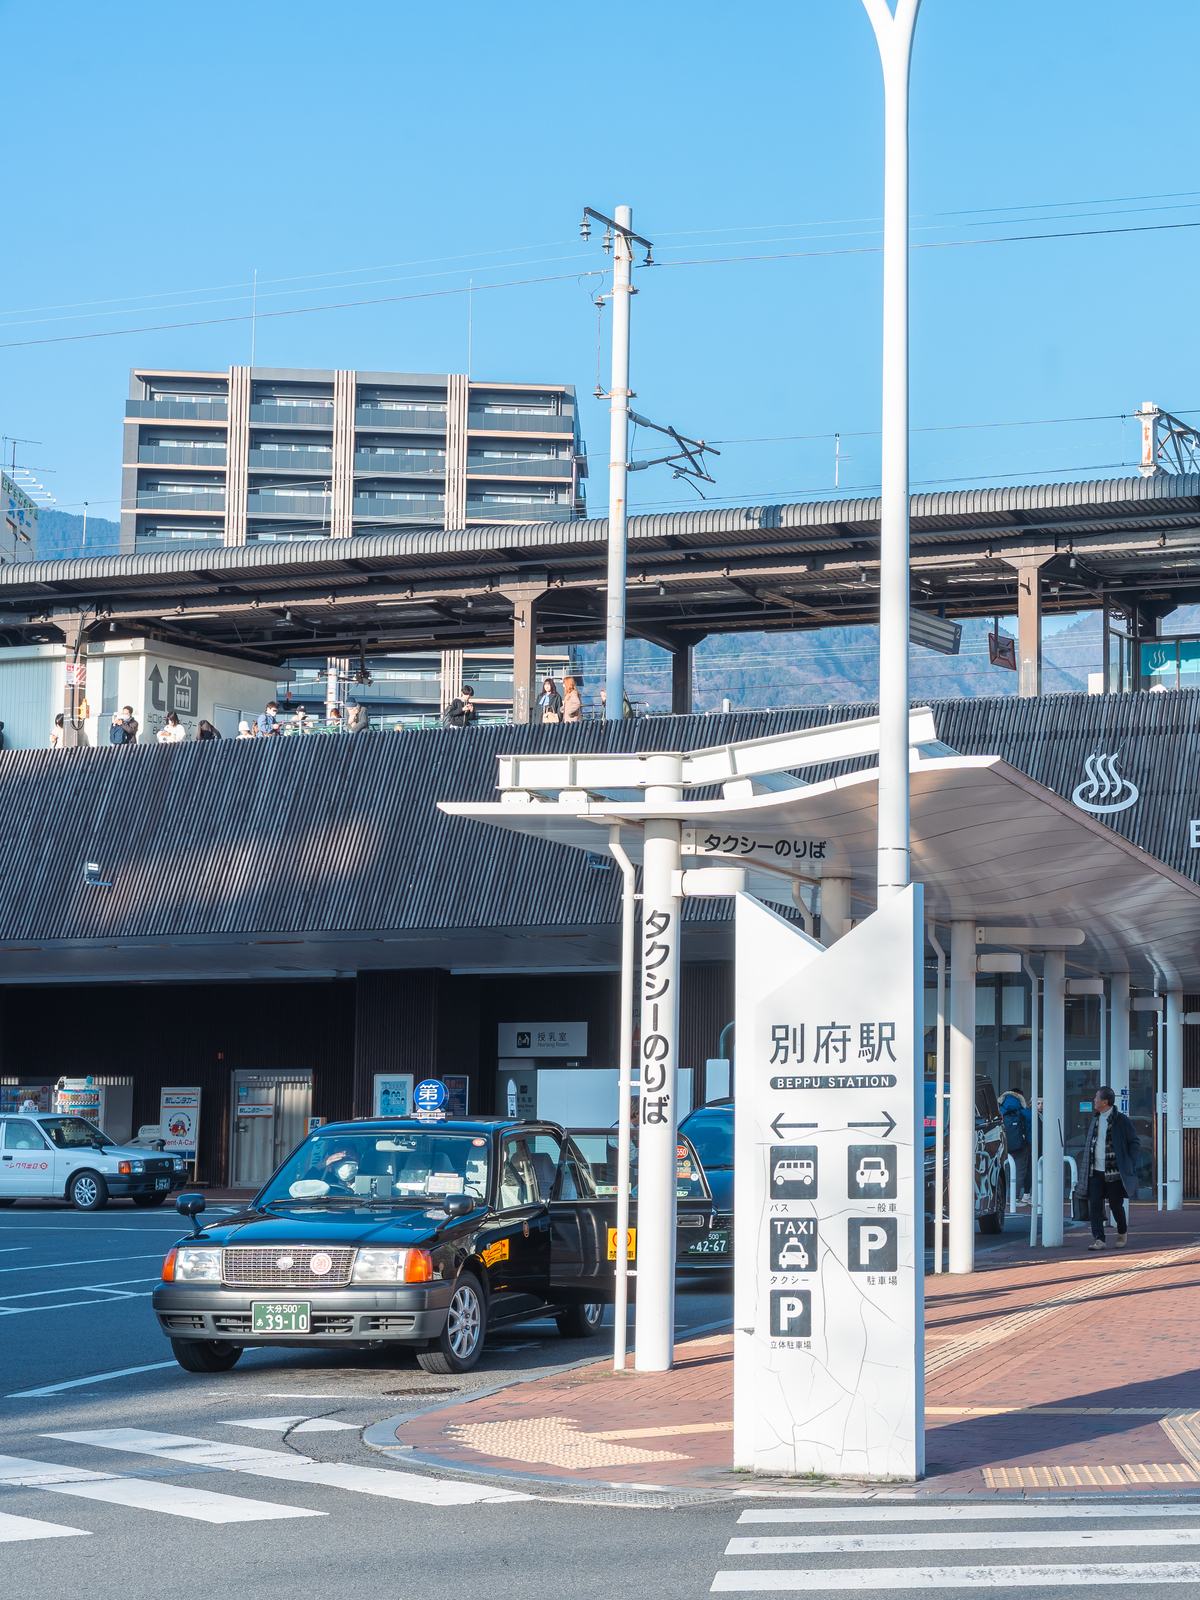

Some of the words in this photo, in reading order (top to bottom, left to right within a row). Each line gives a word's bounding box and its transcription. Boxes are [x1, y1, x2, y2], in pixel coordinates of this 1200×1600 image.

[955, 628, 961, 639] 2
[704, 834, 827, 859] タクシーのりば
[642, 909, 671, 1125] タクシーのりば
[537, 1031, 567, 1042] 授乳室
[769, 1022, 897, 1065] 別府駅
[777, 1077, 821, 1089] BEPPU
[828, 1075, 890, 1087] STATION
[418, 1083, 439, 1105] 第一
[769, 1203, 790, 1212] バス
[866, 1202, 898, 1213] 一般車
[774, 1221, 814, 1235] TAXI
[696, 1240, 726, 1251] 42-67
[859, 1225, 888, 1265] P
[769, 1275, 810, 1286] タクシー
[866, 1275, 898, 1286] 駐車場
[266, 1304, 298, 1313] 大分500
[780, 1296, 804, 1331] P
[256, 1318, 264, 1326] あ
[265, 1314, 307, 1330] 39-10
[770, 1340, 812, 1350] 立体駐車場
